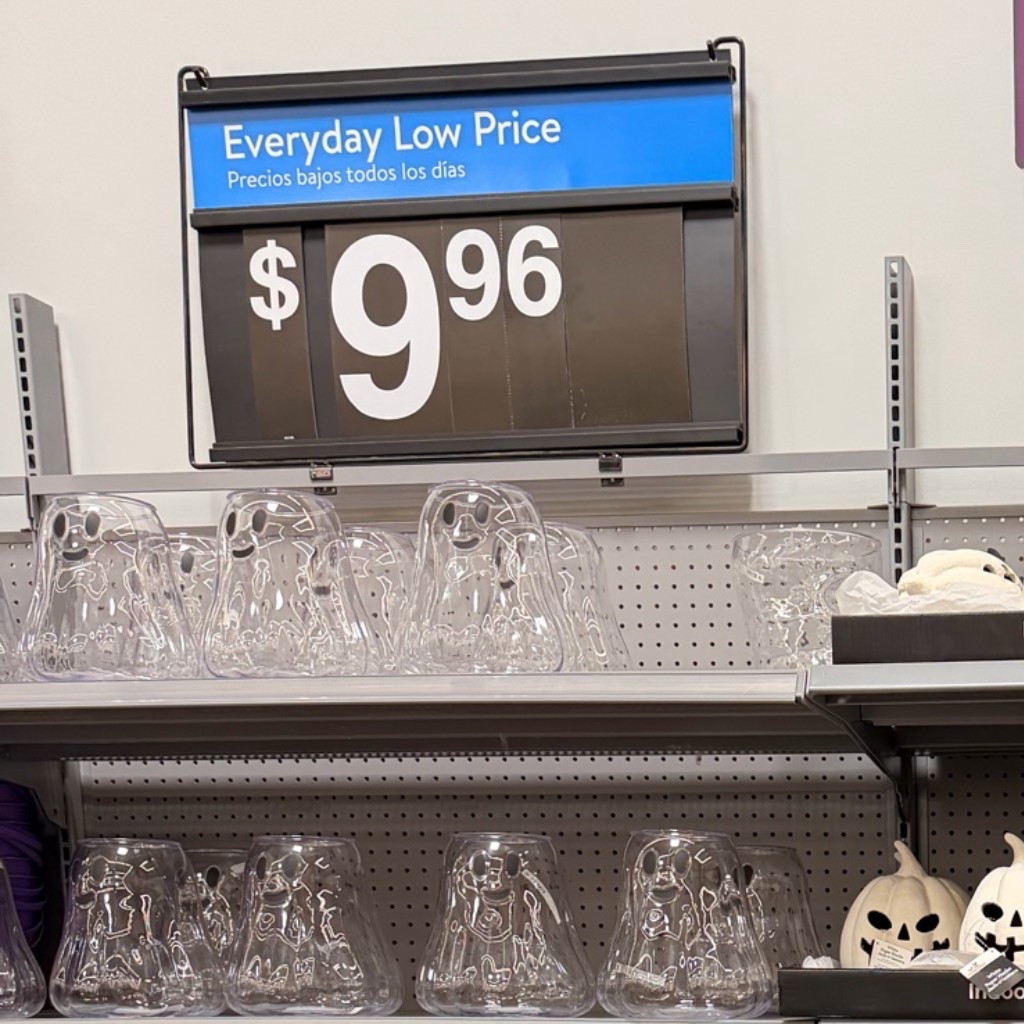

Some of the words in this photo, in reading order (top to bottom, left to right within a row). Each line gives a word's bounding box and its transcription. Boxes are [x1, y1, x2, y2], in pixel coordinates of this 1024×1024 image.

[223, 118, 382, 167] Everyday
[393, 115, 461, 151] Low
[474, 109, 561, 147] Price
[228, 171, 292, 189] Precios
[296, 168, 342, 190] bajos
[346, 164, 397, 183] todos
[402, 163, 427, 180] los
[431, 161, 466, 179] días
